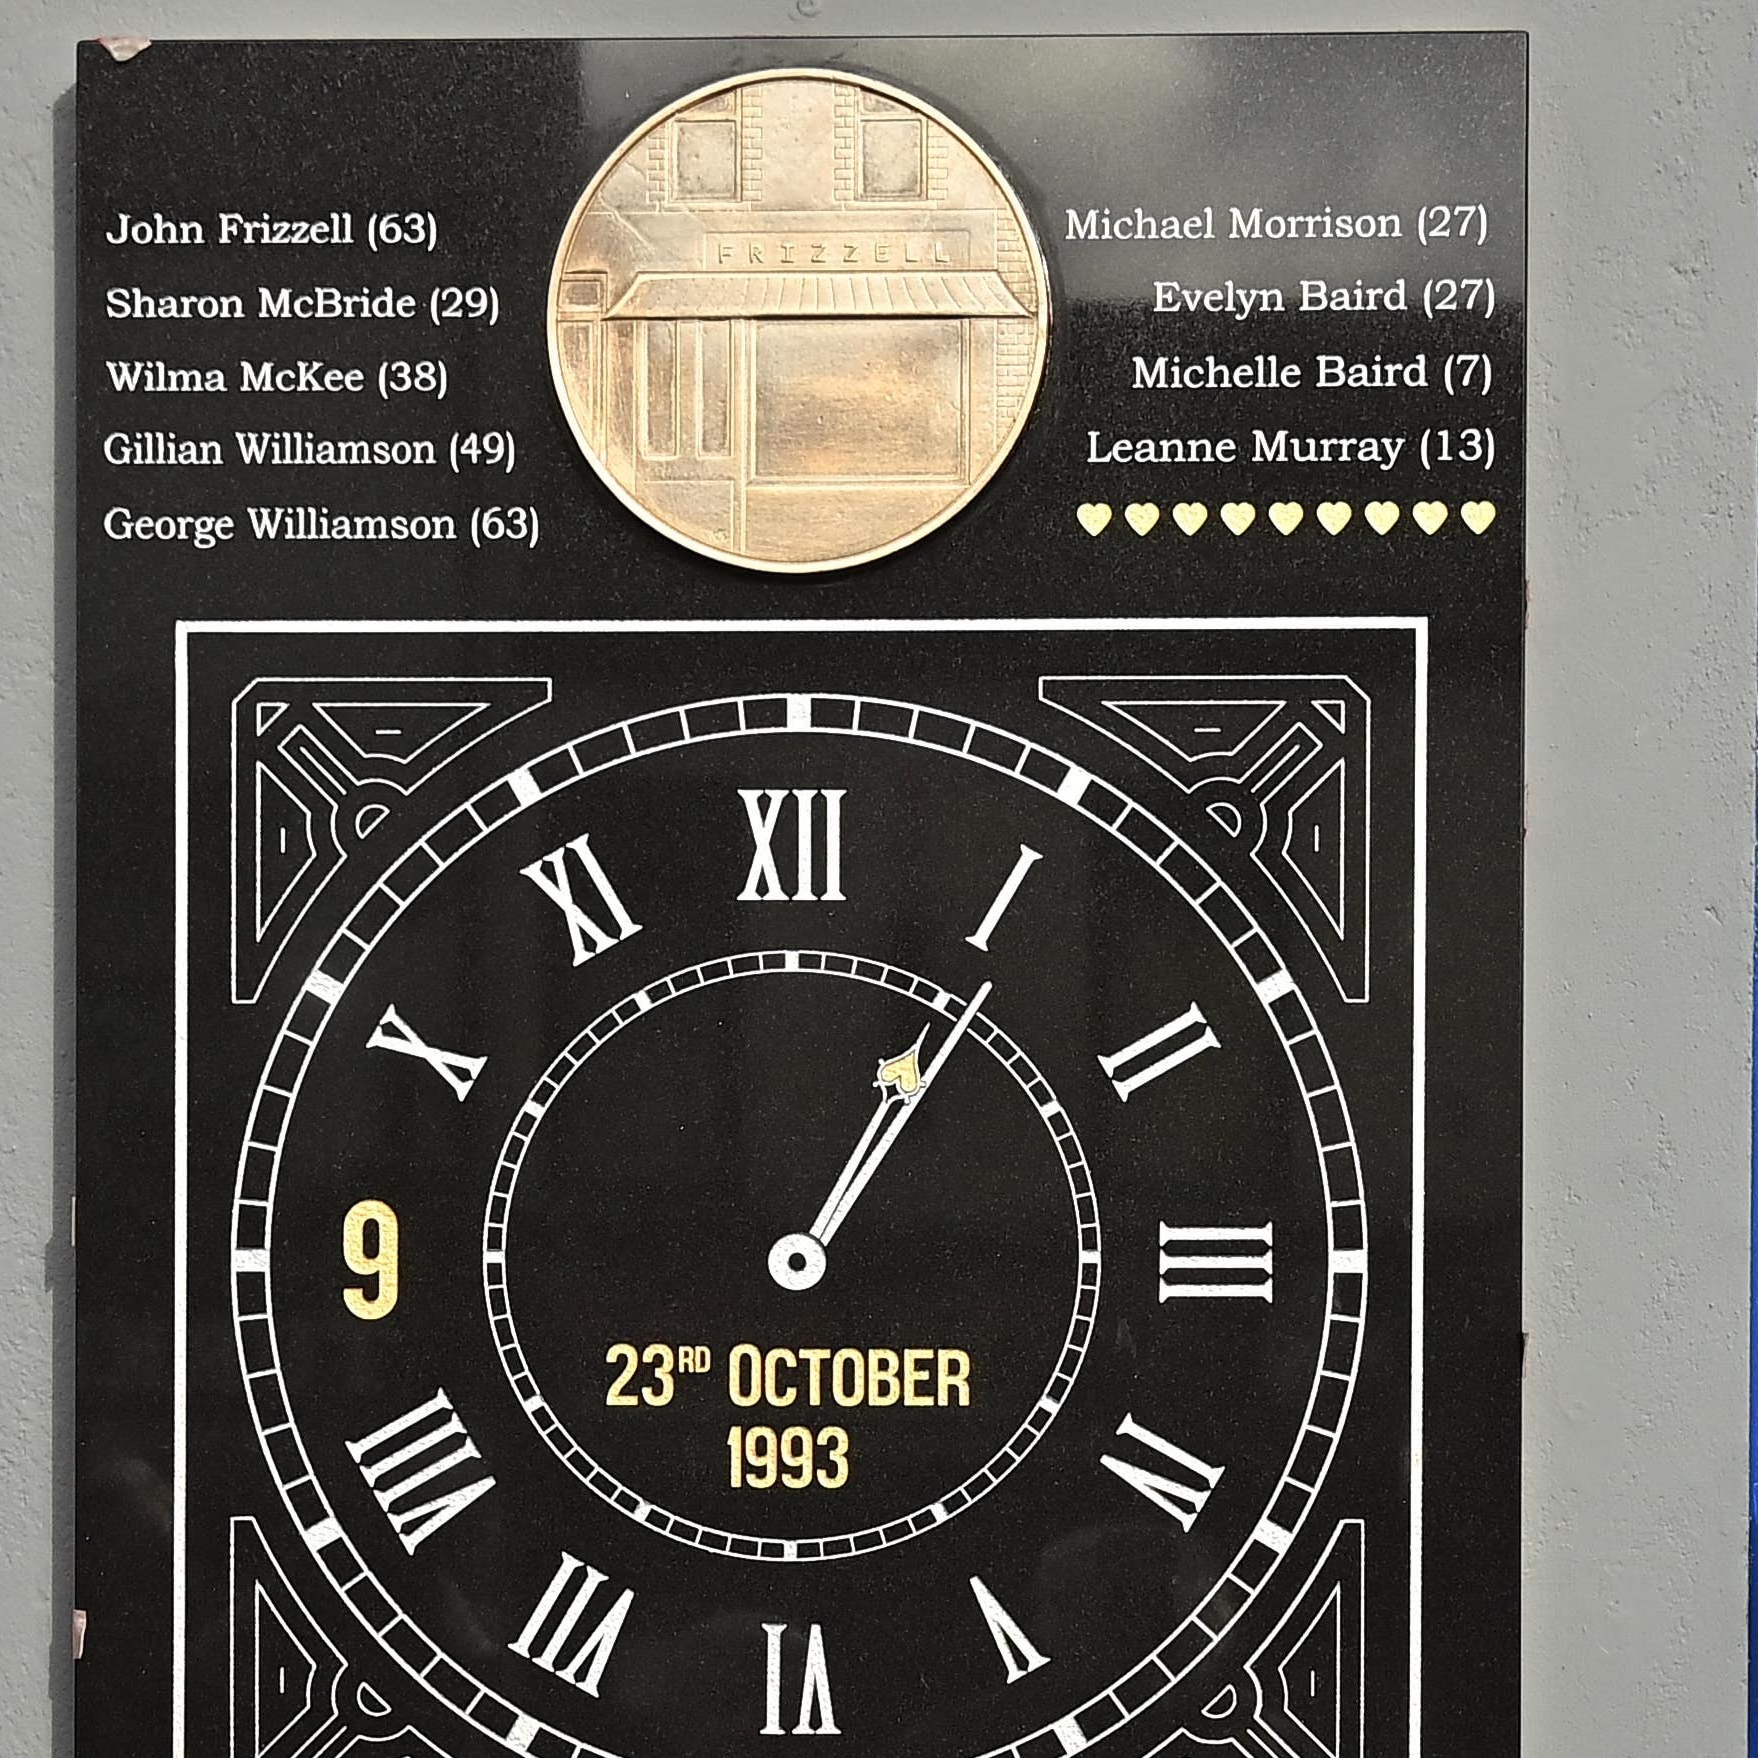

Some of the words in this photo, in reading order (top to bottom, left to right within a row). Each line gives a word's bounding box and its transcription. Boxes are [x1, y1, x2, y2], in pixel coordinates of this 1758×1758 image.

[107, 212, 205, 245] John
[218, 212, 354, 244] Frizzell
[368, 211, 438, 252] (63)
[1065, 206, 1216, 240] Michael
[1228, 206, 1403, 240] Morrison
[1418, 204, 1488, 246] (27)
[717, 243, 951, 265] FRIZZELL
[106, 287, 245, 319] Sharon
[258, 286, 415, 319] McBride
[429, 286, 500, 326] (29)
[1153, 280, 1286, 321] Evelyn
[1298, 278, 1408, 312] Baird
[1423, 278, 1495, 320] (27)
[105, 360, 228, 392] Wilma
[240, 361, 364, 392] McKee
[378, 360, 447, 400] (38)
[1132, 354, 1302, 389] Michelle
[1315, 354, 1429, 388] Baird
[1444, 353, 1493, 396] (7)
[103, 432, 224, 465] Gillian
[235, 432, 437, 465] Williamson
[450, 431, 516, 474] (49)
[1087, 430, 1236, 463] Leanne
[1251, 430, 1407, 471] Murray
[1420, 428, 1496, 470] (13)
[103, 507, 235, 549] George
[246, 507, 457, 541] Williamson
[471, 506, 540, 549] (63)
[736, 788, 848, 902] XII
[520, 832, 644, 968] XI
[365, 1003, 489, 1103] X
[1096, 1001, 1223, 1103] II
[341, 1199, 400, 1321] 9
[605, 1343, 711, 1408] 23RD
[728, 1343, 971, 1408] OCTOBER
[726, 1426, 850, 1490] 1993
